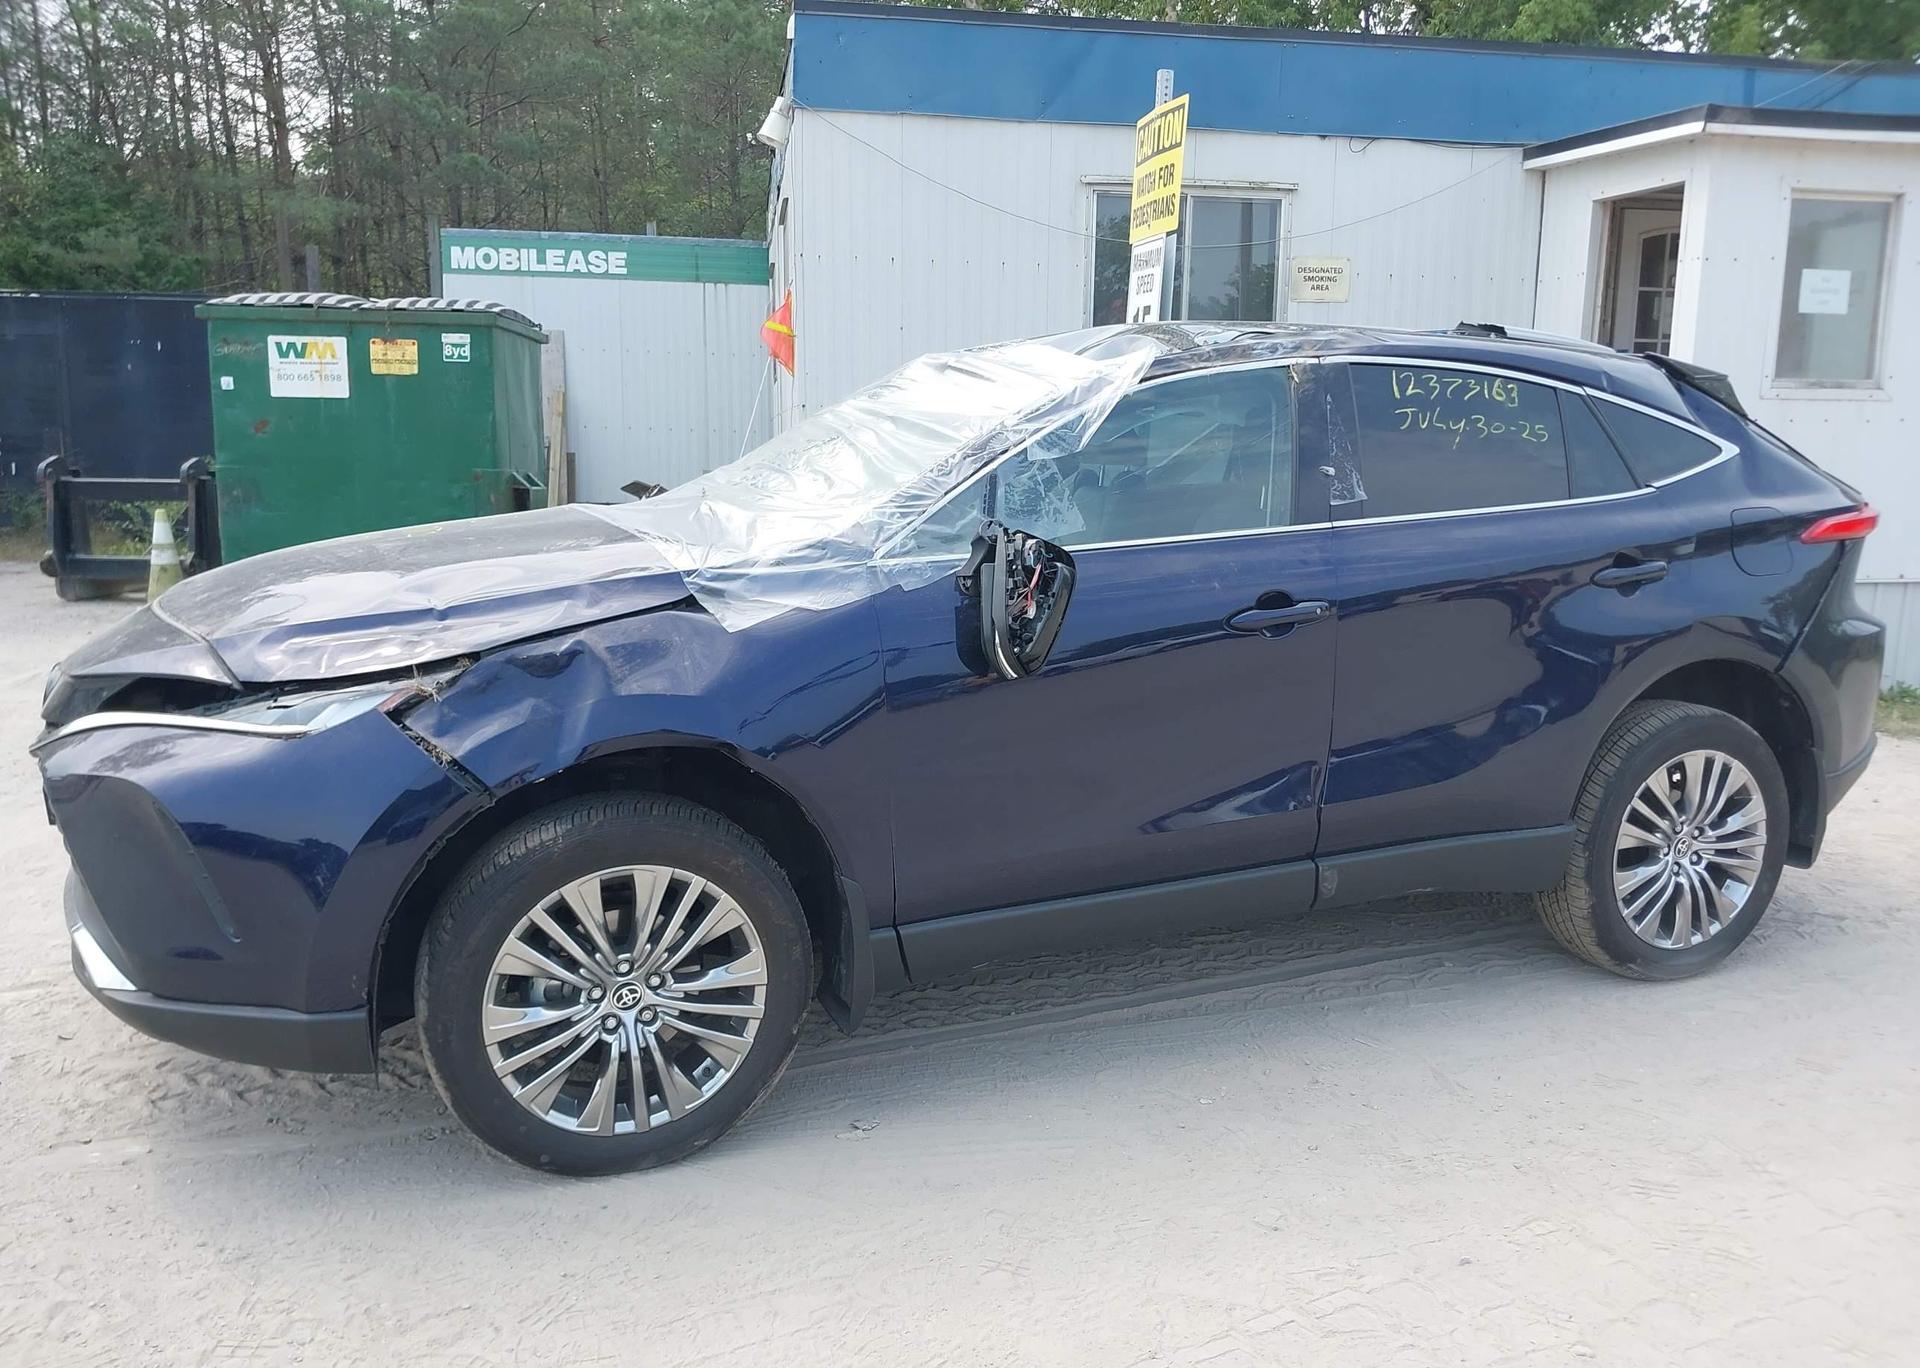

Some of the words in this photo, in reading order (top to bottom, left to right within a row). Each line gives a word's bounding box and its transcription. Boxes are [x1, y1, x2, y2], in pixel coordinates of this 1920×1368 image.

[1137, 108, 1184, 163] CAUTION
[1136, 168, 1157, 200] WATCH
[1157, 163, 1175, 190] FOR
[1132, 193, 1176, 228] PEDESTRIANS
[450, 246, 628, 275] MOBILEASE
[1297, 266, 1344, 275] DESIGNATED
[1303, 275, 1338, 283] SMOKING
[1136, 274, 1154, 295] SPEED
[274, 341, 337, 359] WM
[444, 344, 469, 359] 8yd
[277, 373, 296, 383] 800
[297, 373, 316, 383] 665
[319, 373, 343, 383] 1898
